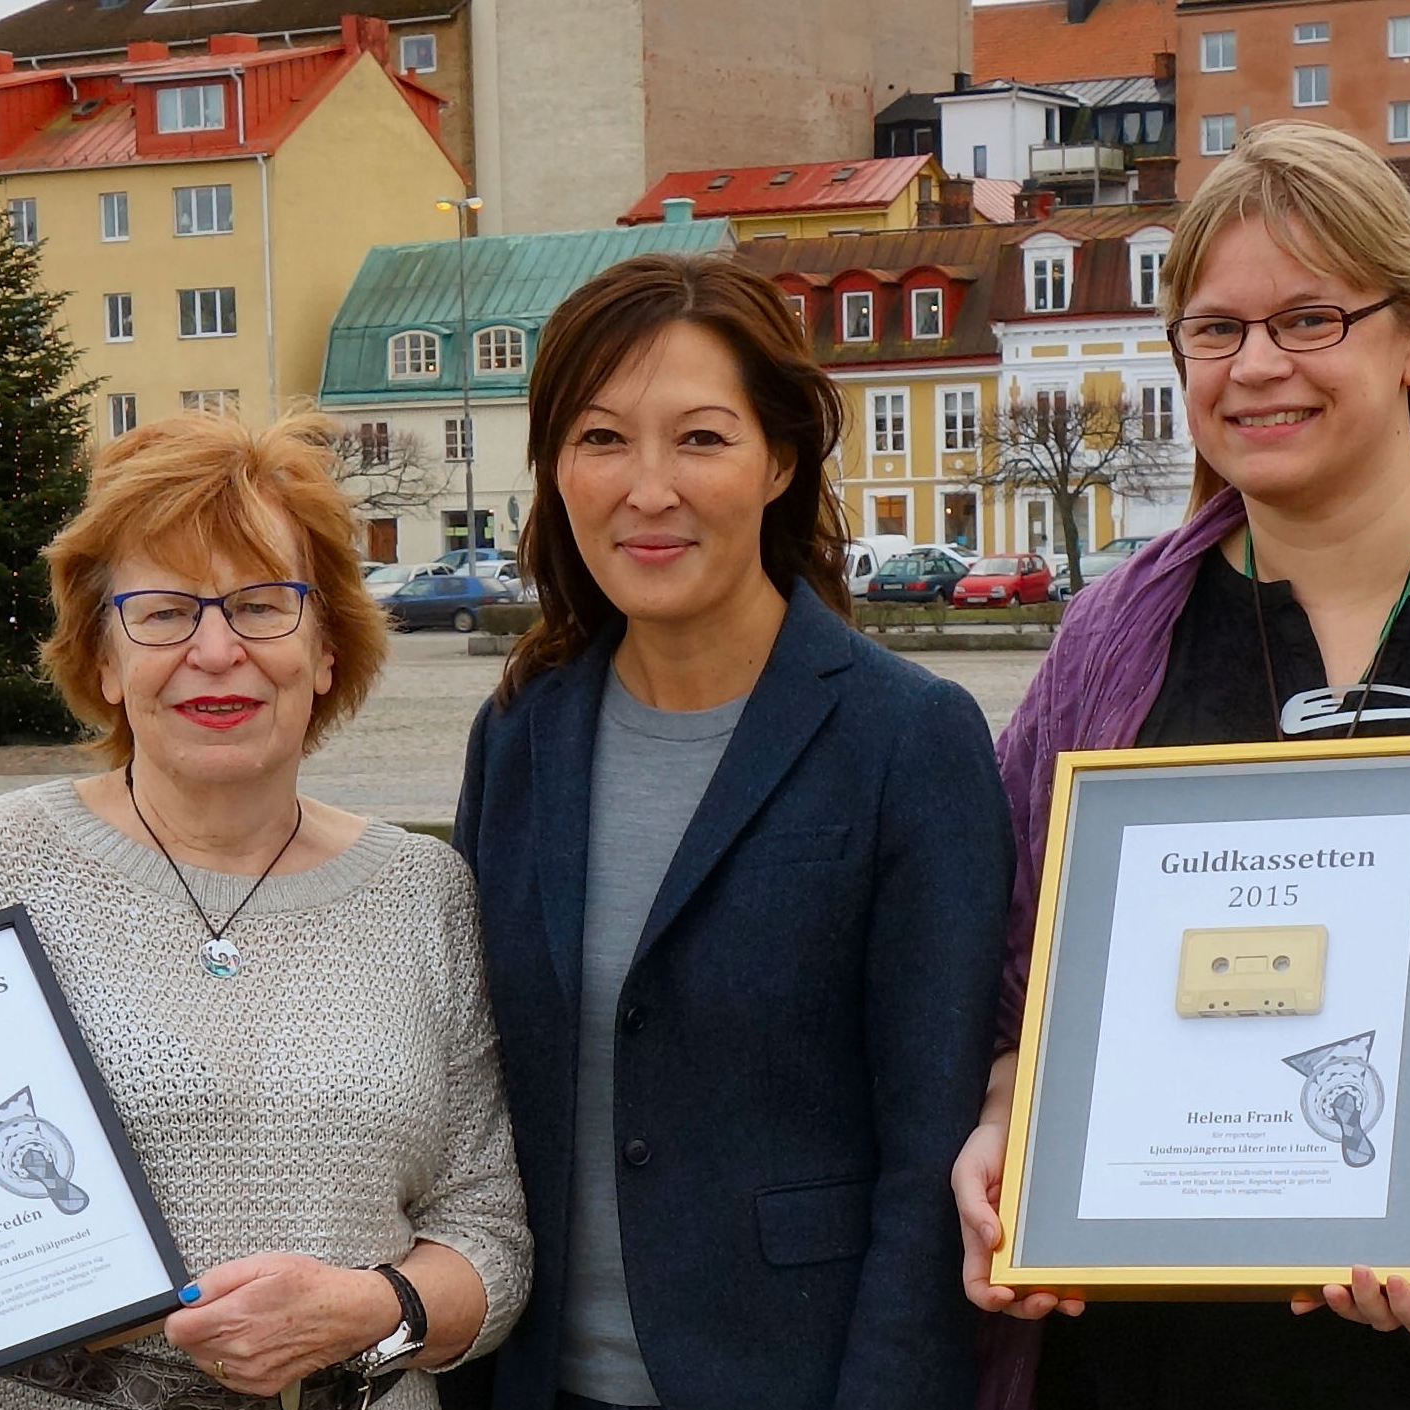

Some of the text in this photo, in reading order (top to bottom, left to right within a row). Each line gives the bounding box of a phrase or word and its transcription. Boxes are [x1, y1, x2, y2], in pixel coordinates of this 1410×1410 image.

[1161, 849, 1375, 874] Guldkassetten
[1228, 884, 1298, 908] 2015
[1187, 1110, 1293, 1124] Helena Frank
[1225, 1132, 1266, 1140] reportaget
[1150, 1145, 1236, 1156] Ljudmojängerna
[1238, 1144, 1264, 1153] låter
[1266, 1145, 1287, 1153] inte
[1295, 1143, 1327, 1152] luften
[11, 1250, 34, 1262] utan
[35, 1228, 91, 1254] hjälpmedel
